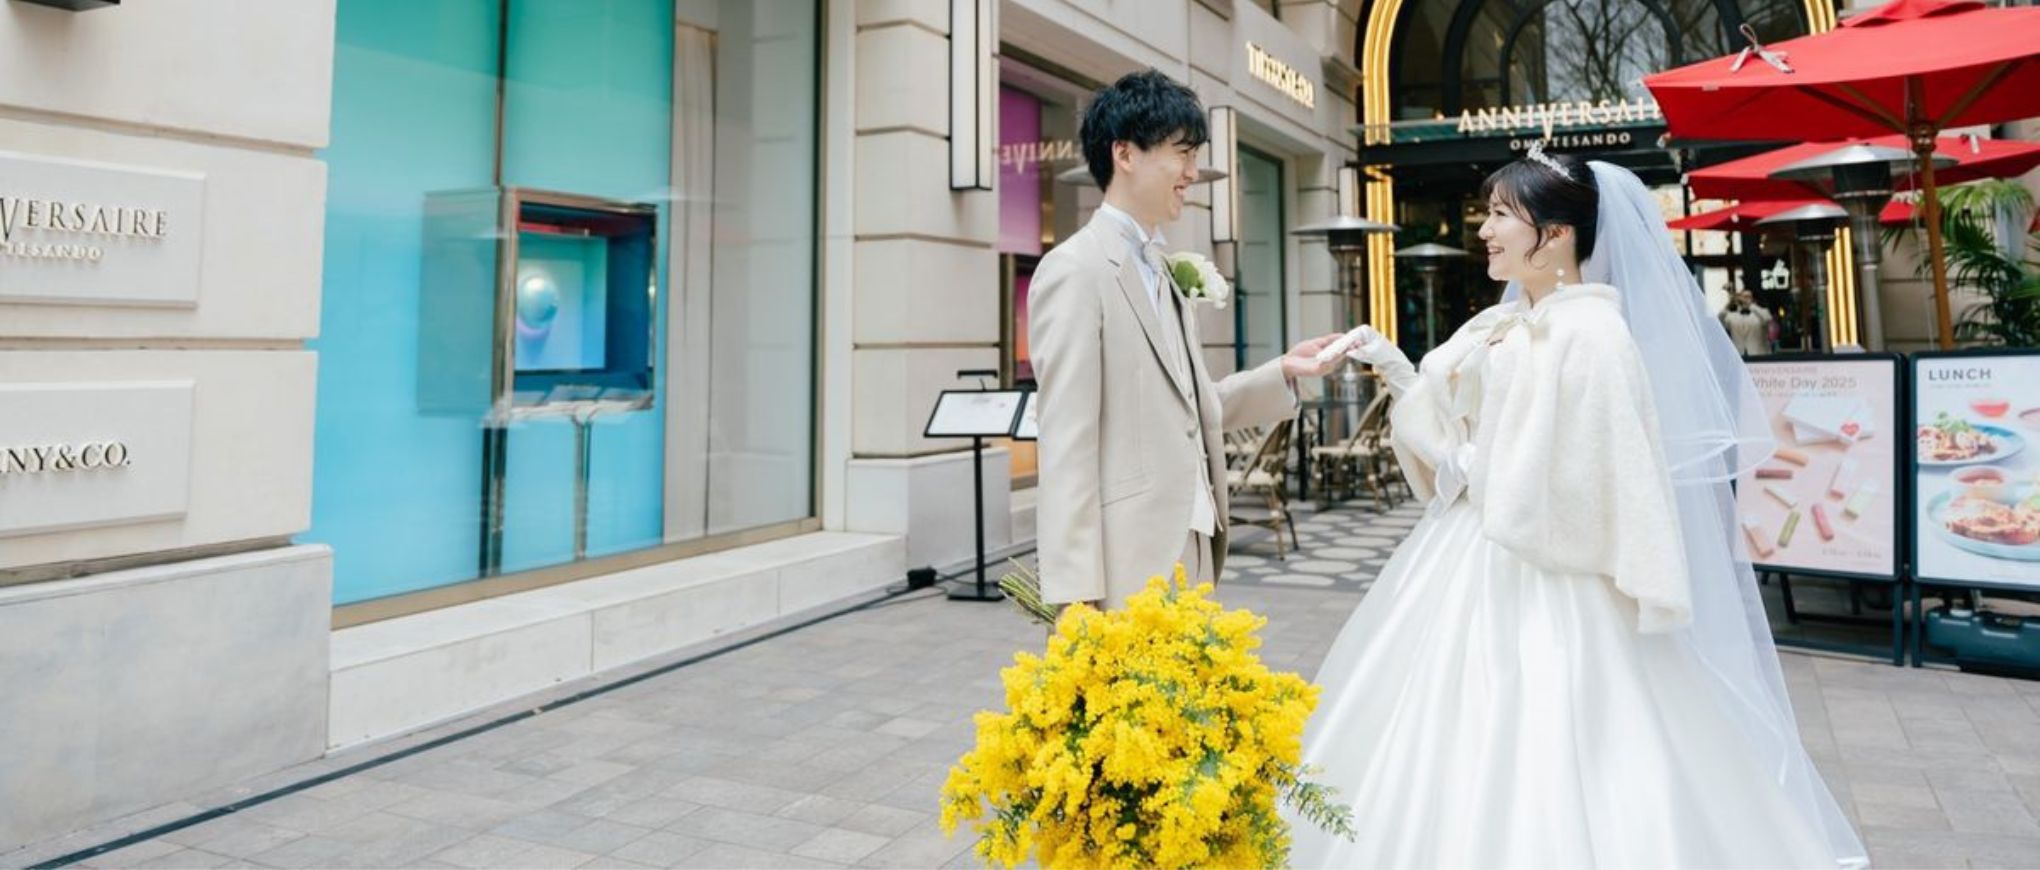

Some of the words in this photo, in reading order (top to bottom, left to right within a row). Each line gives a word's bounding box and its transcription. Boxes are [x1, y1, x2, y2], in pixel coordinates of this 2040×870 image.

[1928, 367, 1992, 381] LUNCH
[1790, 376, 1818, 391] Day
[1821, 375, 1857, 389] 2025
[0, 441, 131, 473] NY&CO.
